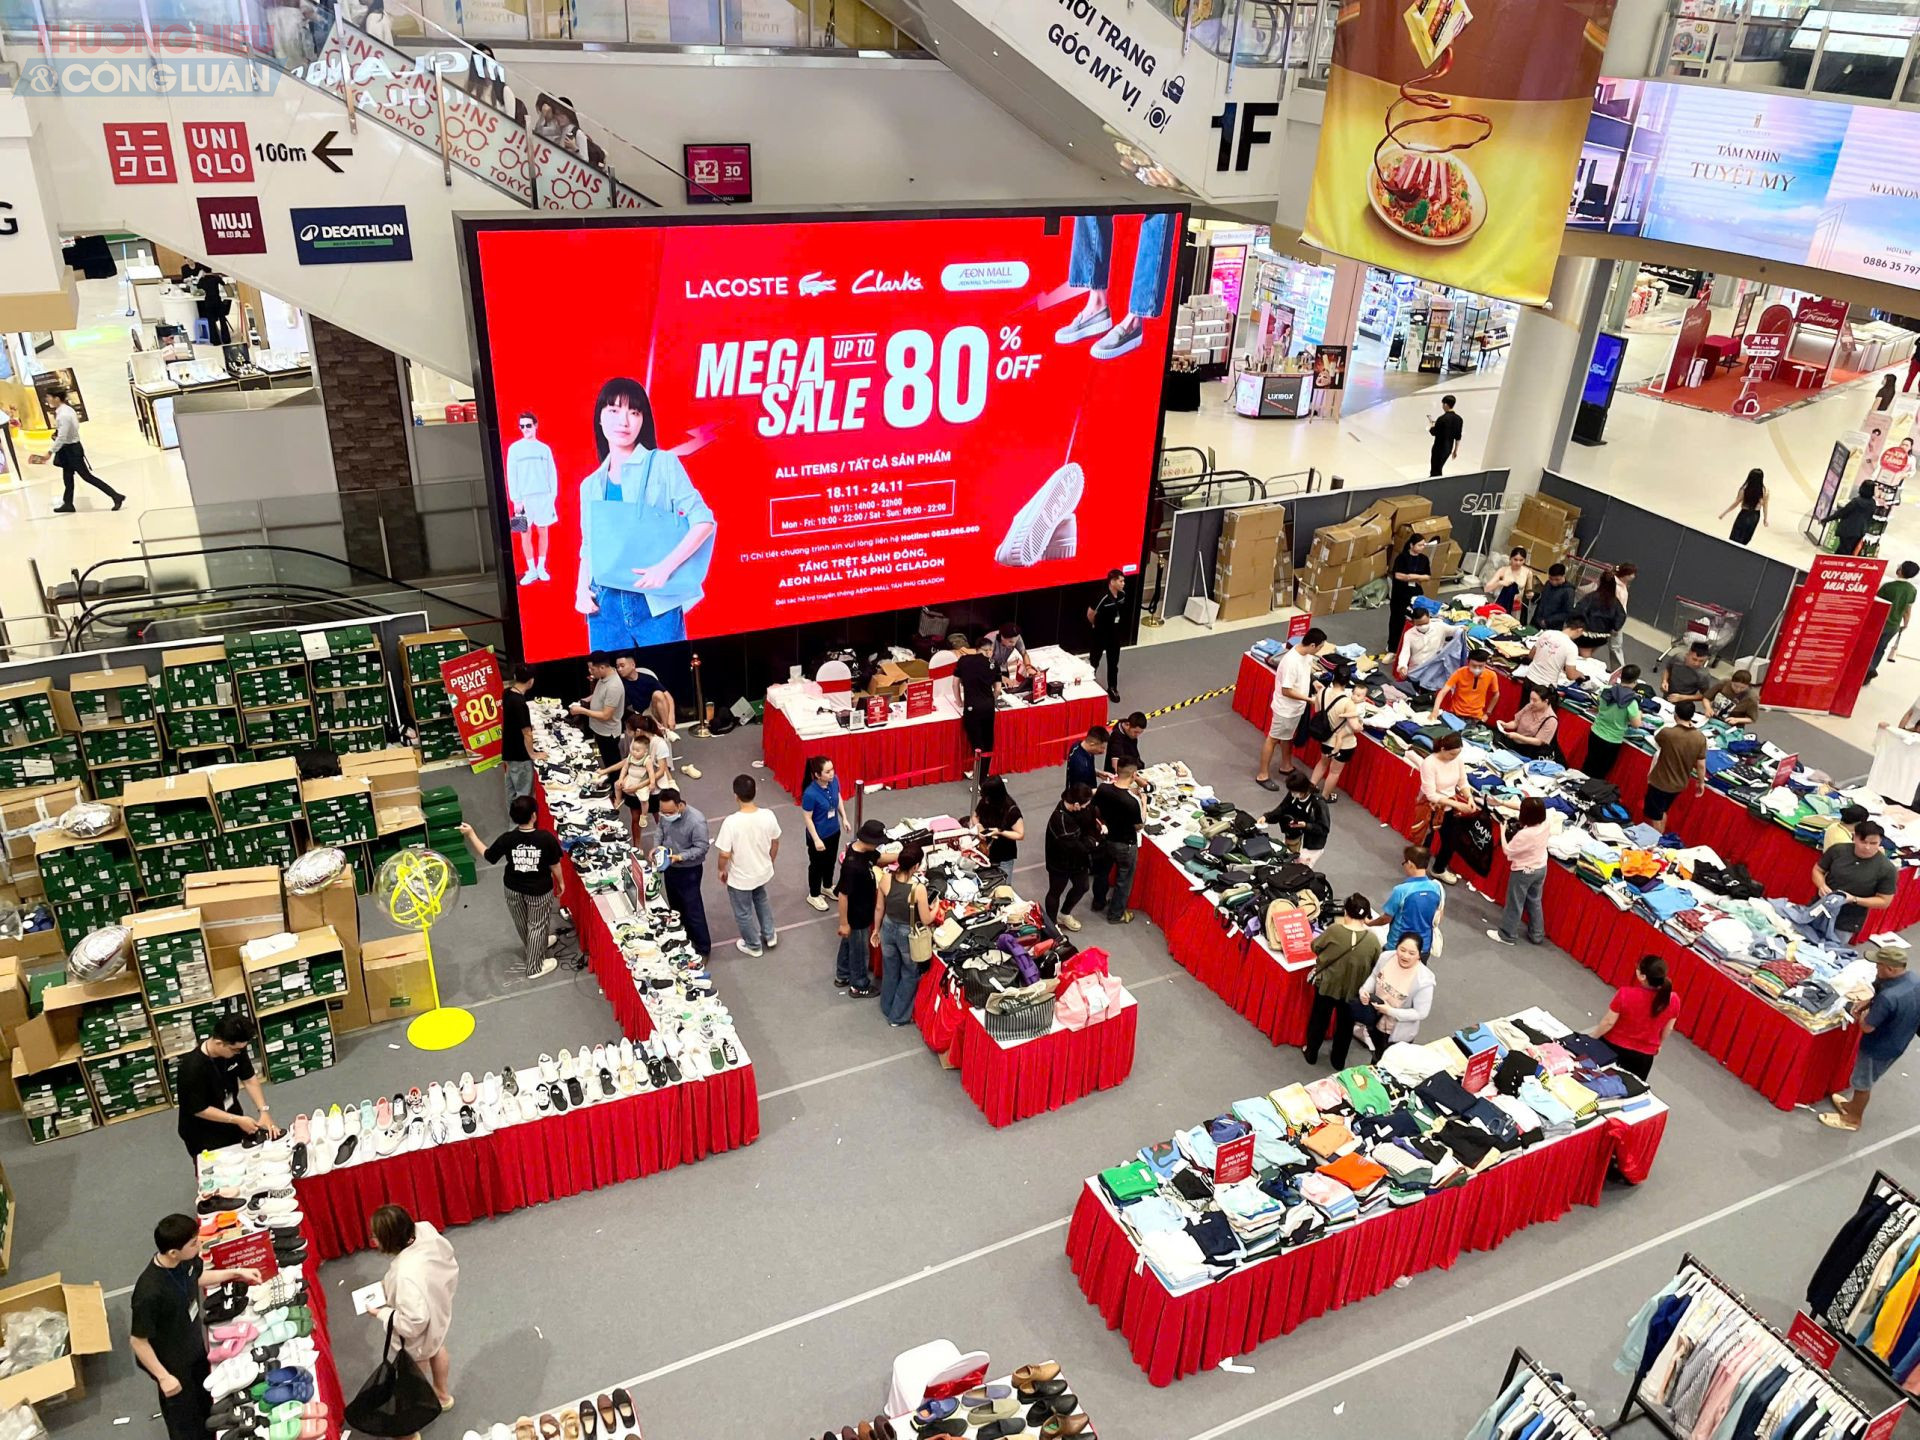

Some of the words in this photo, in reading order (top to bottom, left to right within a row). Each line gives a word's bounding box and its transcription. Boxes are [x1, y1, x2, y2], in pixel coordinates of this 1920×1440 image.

[1097, 16, 1156, 77] TRANG
[1048, 24, 1091, 65] GÓC
[1089, 56, 1124, 89] MỸ
[1121, 81, 1142, 112] VỊ
[191, 127, 238, 149] UNI
[1211, 102, 1280, 171] 1F
[255, 142, 307, 162] 100m
[1747, 146, 1781, 163] NHÌN
[196, 153, 246, 178] QLO
[725, 166, 741, 176] 30
[1690, 161, 1754, 189] TUYỆT
[1870, 182, 1880, 192] M
[210, 212, 253, 230] MUJI
[322, 224, 404, 239] DECATHLON
[1886, 246, 1913, 256] HOTLINE
[986, 266, 1013, 277] MALL
[1863, 256, 1888, 268] 0886
[1889, 261, 1901, 271] 35
[685, 277, 789, 298] LACOSTE
[851, 269, 922, 294] Clarks
[833, 340, 854, 359] UP
[857, 338, 875, 358] TO
[999, 325, 1022, 351] %
[695, 336, 825, 399] MEGA
[883, 325, 990, 429] 80
[996, 354, 1042, 381] OFF
[757, 378, 871, 437] SALE
[775, 466, 799, 479] ALL
[801, 463, 838, 476] ITEMS
[840, 461, 846, 473] /
[872, 454, 889, 469] CẢ
[891, 452, 915, 467] SẢN
[826, 485, 859, 499] 18.11
[870, 480, 903, 494] 24.11
[829, 503, 852, 513] 18/11:
[854, 500, 875, 511] 14h00
[881, 497, 902, 508] 22h00
[781, 520, 798, 529] Mon
[804, 518, 816, 528] Fri:
[817, 515, 837, 526] 10:00
[843, 513, 863, 523] 22:00
[869, 510, 881, 520] Sat
[886, 508, 901, 518] Sun:
[903, 506, 922, 516] 09:00
[928, 503, 947, 513] 22:00
[844, 541, 856, 549] vui
[900, 532, 930, 542] Hotline:
[831, 555, 858, 568] TRỆT
[860, 552, 890, 564] SẢNH
[778, 576, 811, 588] AEON
[813, 571, 843, 584] MALL
[846, 568, 868, 579] TÂN
[869, 563, 892, 576] PHÚ
[895, 557, 945, 572] CELADON
[1820, 569, 1841, 579] QUY
[1840, 572, 1864, 582] ĐỊNH
[855, 586, 873, 594] AEON
[916, 577, 945, 586] CELADON
[1823, 581, 1847, 591] MUA
[450, 665, 493, 688] PRIVATE
[461, 675, 487, 693] SALE
[465, 693, 498, 726] 80
[511, 849, 527, 858] FOR
[527, 849, 542, 858] THE
